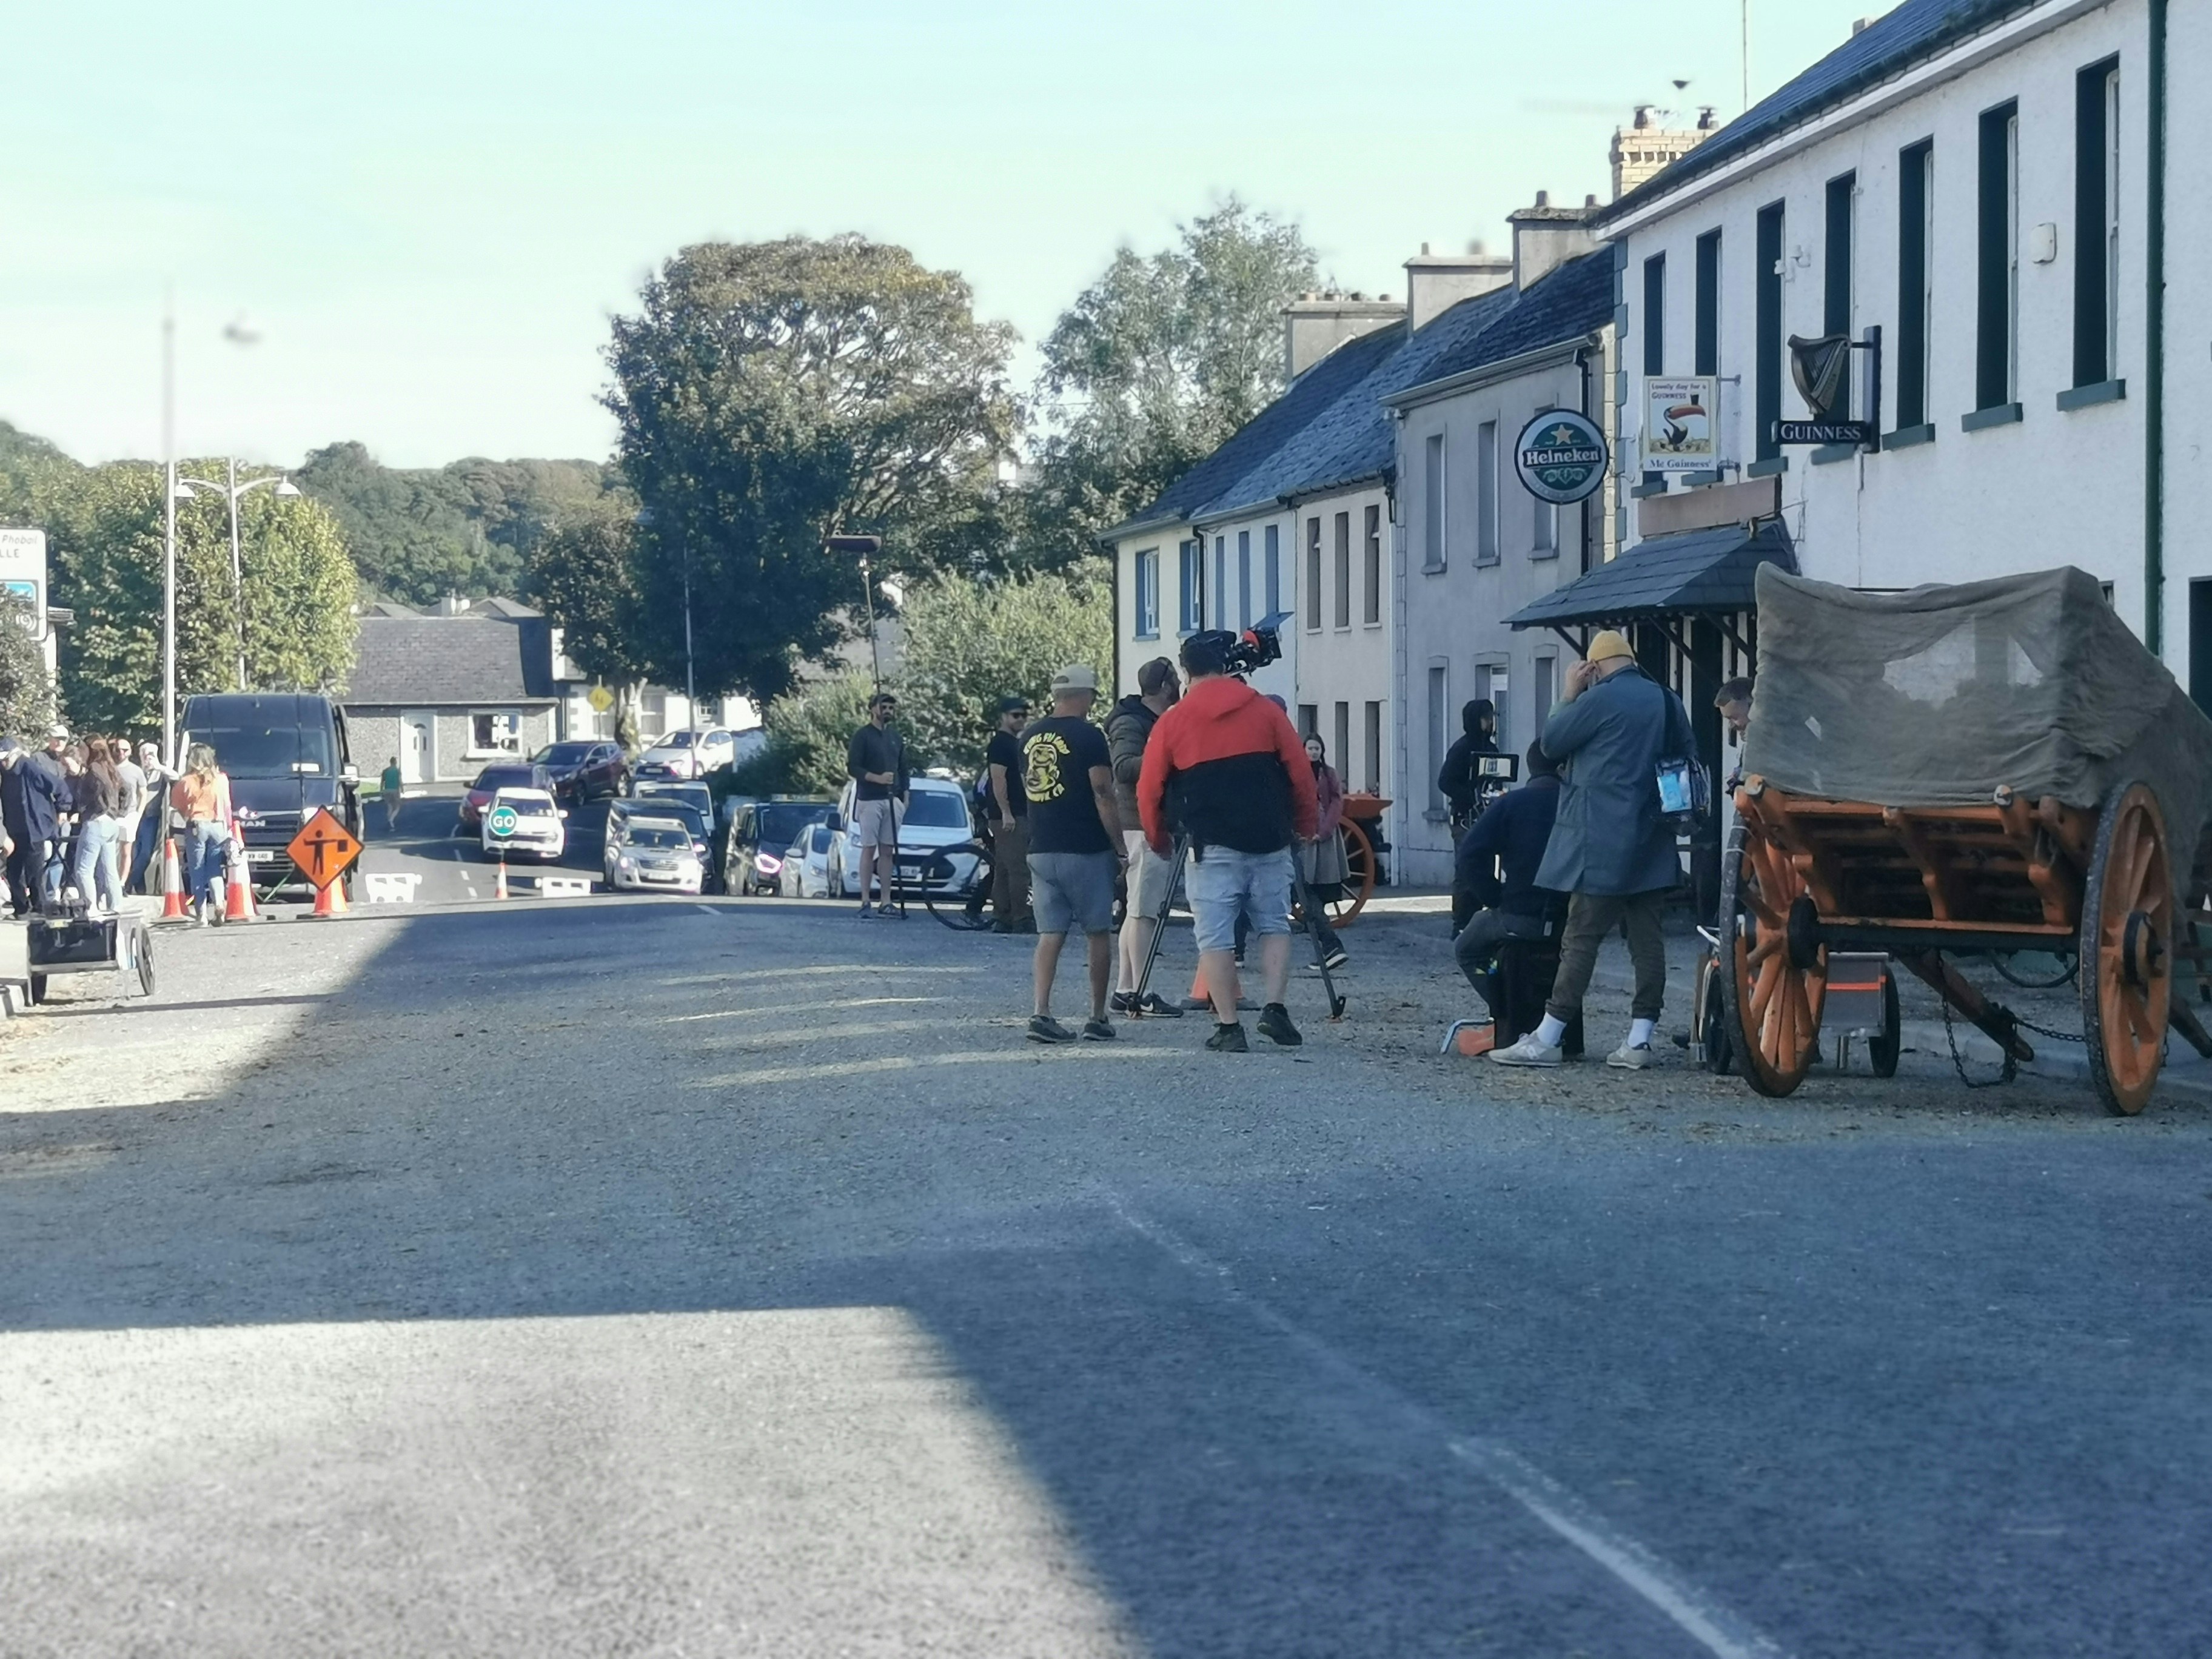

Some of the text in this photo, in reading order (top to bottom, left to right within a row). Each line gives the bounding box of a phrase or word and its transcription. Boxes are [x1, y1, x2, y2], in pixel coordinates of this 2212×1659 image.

[1780, 424, 1861, 440] GUINNESS
[1526, 447, 1599, 466] Heineken
[493, 816, 515, 827] GO
